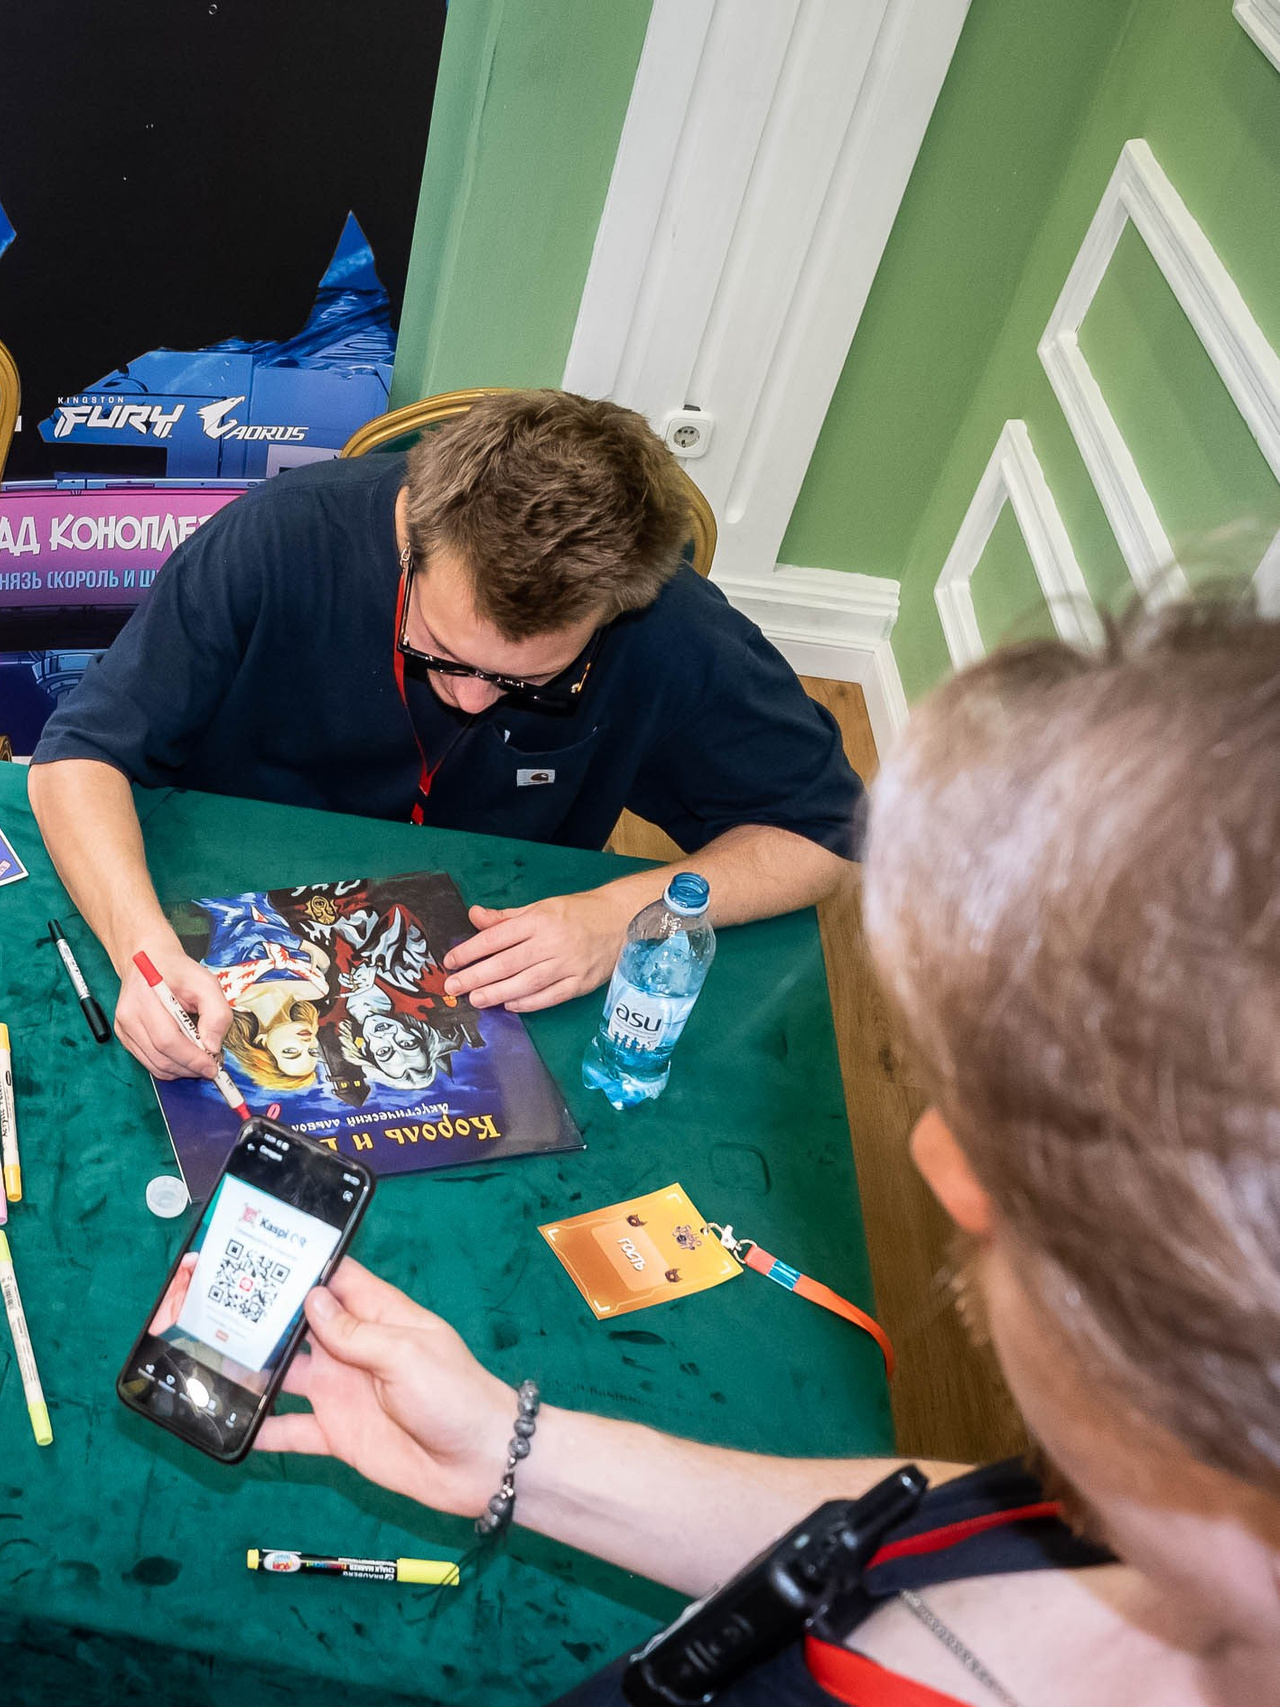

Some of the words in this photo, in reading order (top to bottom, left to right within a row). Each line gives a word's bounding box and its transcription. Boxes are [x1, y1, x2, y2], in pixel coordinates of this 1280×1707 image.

[57, 396, 125, 405] KINGSTON
[53, 404, 186, 439] FURY
[224, 424, 310, 441] AORUS
[48, 512, 214, 552] КОНОПЛЕ
[46, 569, 120, 590] (КОРОЛЬ
[123, 569, 136, 588] И
[615, 1002, 662, 1032] asu
[345, 1102, 450, 1128] Акустический
[383, 1113, 502, 1146] Король
[260, 1217, 290, 1239] Kaspi
[616, 1237, 648, 1272] ГОСТЬ
